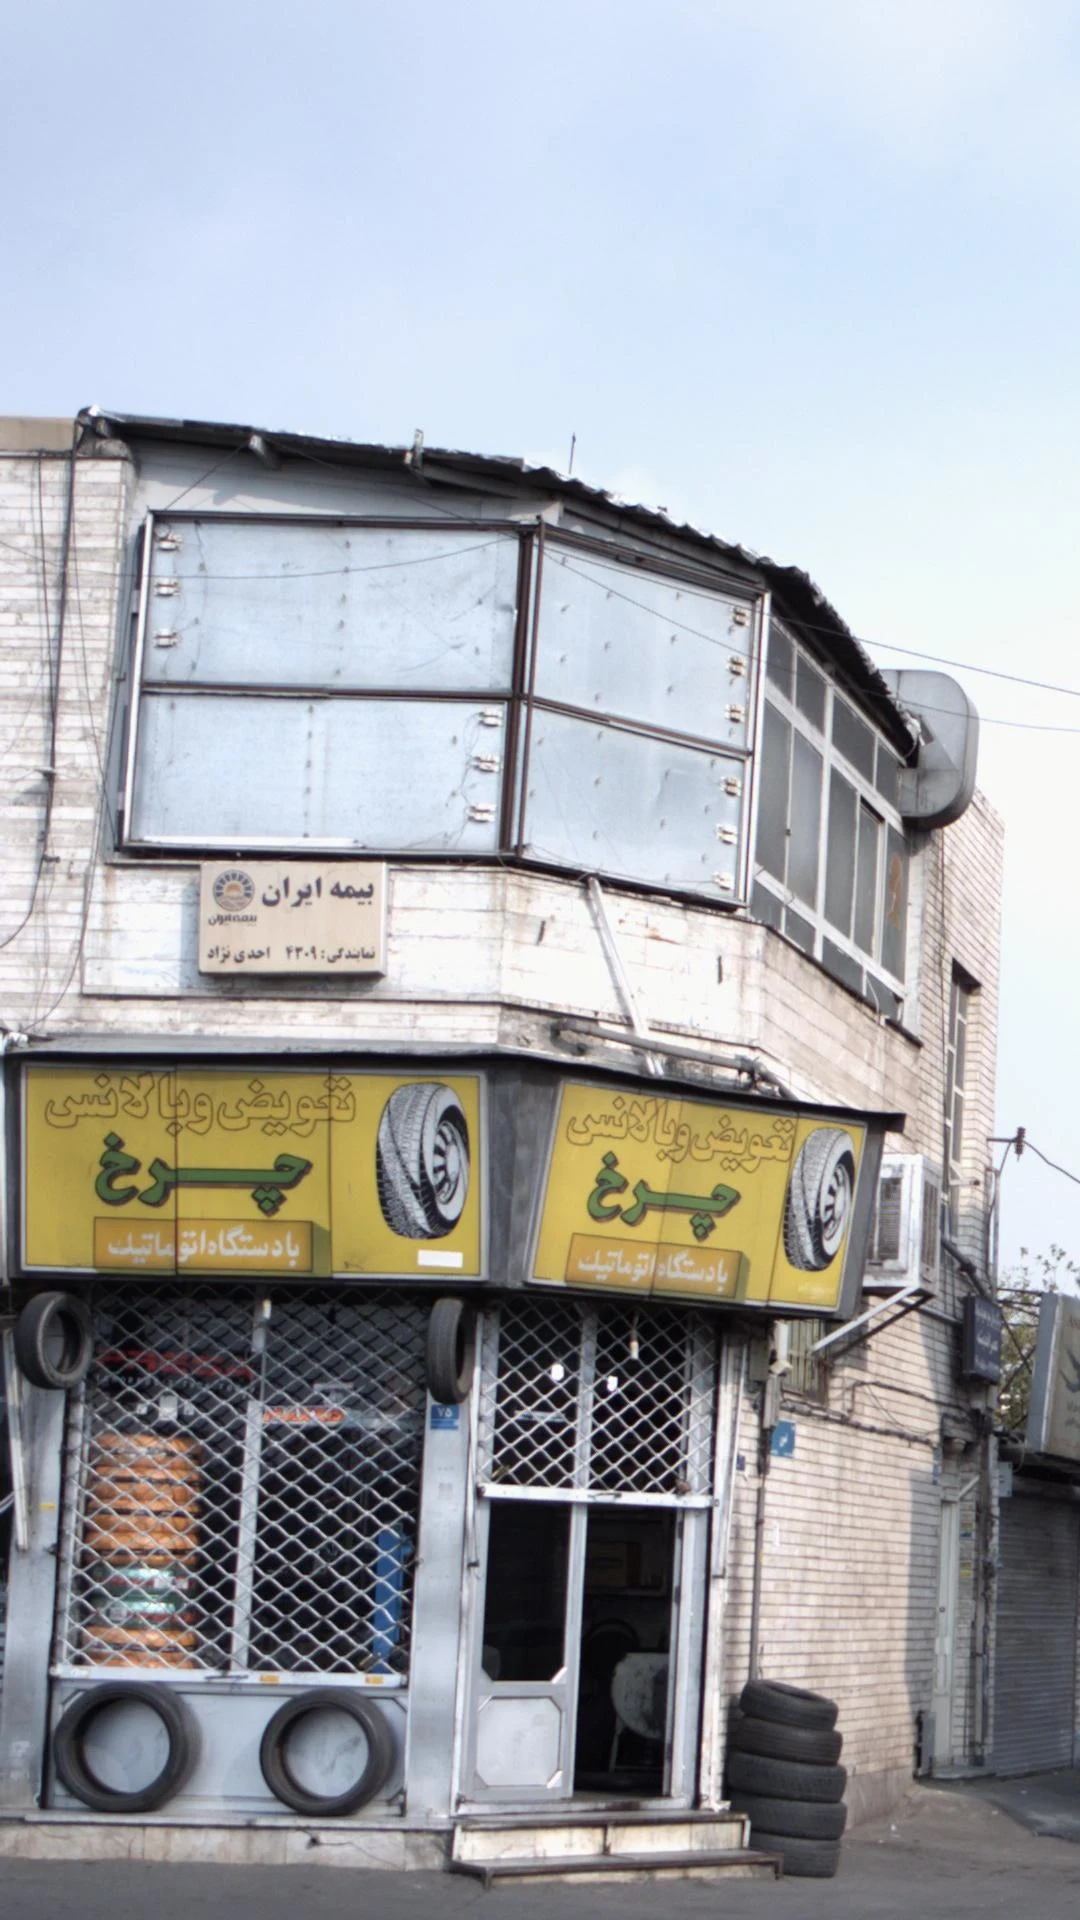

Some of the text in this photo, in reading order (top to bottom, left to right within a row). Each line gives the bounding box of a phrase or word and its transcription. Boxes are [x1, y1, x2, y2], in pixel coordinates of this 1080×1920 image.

[262, 876, 374, 907] بیمه ایران
[217, 1076, 357, 1137] تعویض
[691, 1114, 797, 1173] تعویض
[94, 1131, 314, 1217] چرخ
[587, 1150, 741, 1242] چرخ
[108, 1230, 206, 1265] اتوماتیک
[207, 1225, 283, 1257] دستگاه
[577, 1249, 657, 1283] اتوماتیک
[657, 1250, 715, 1282] دستگاه
